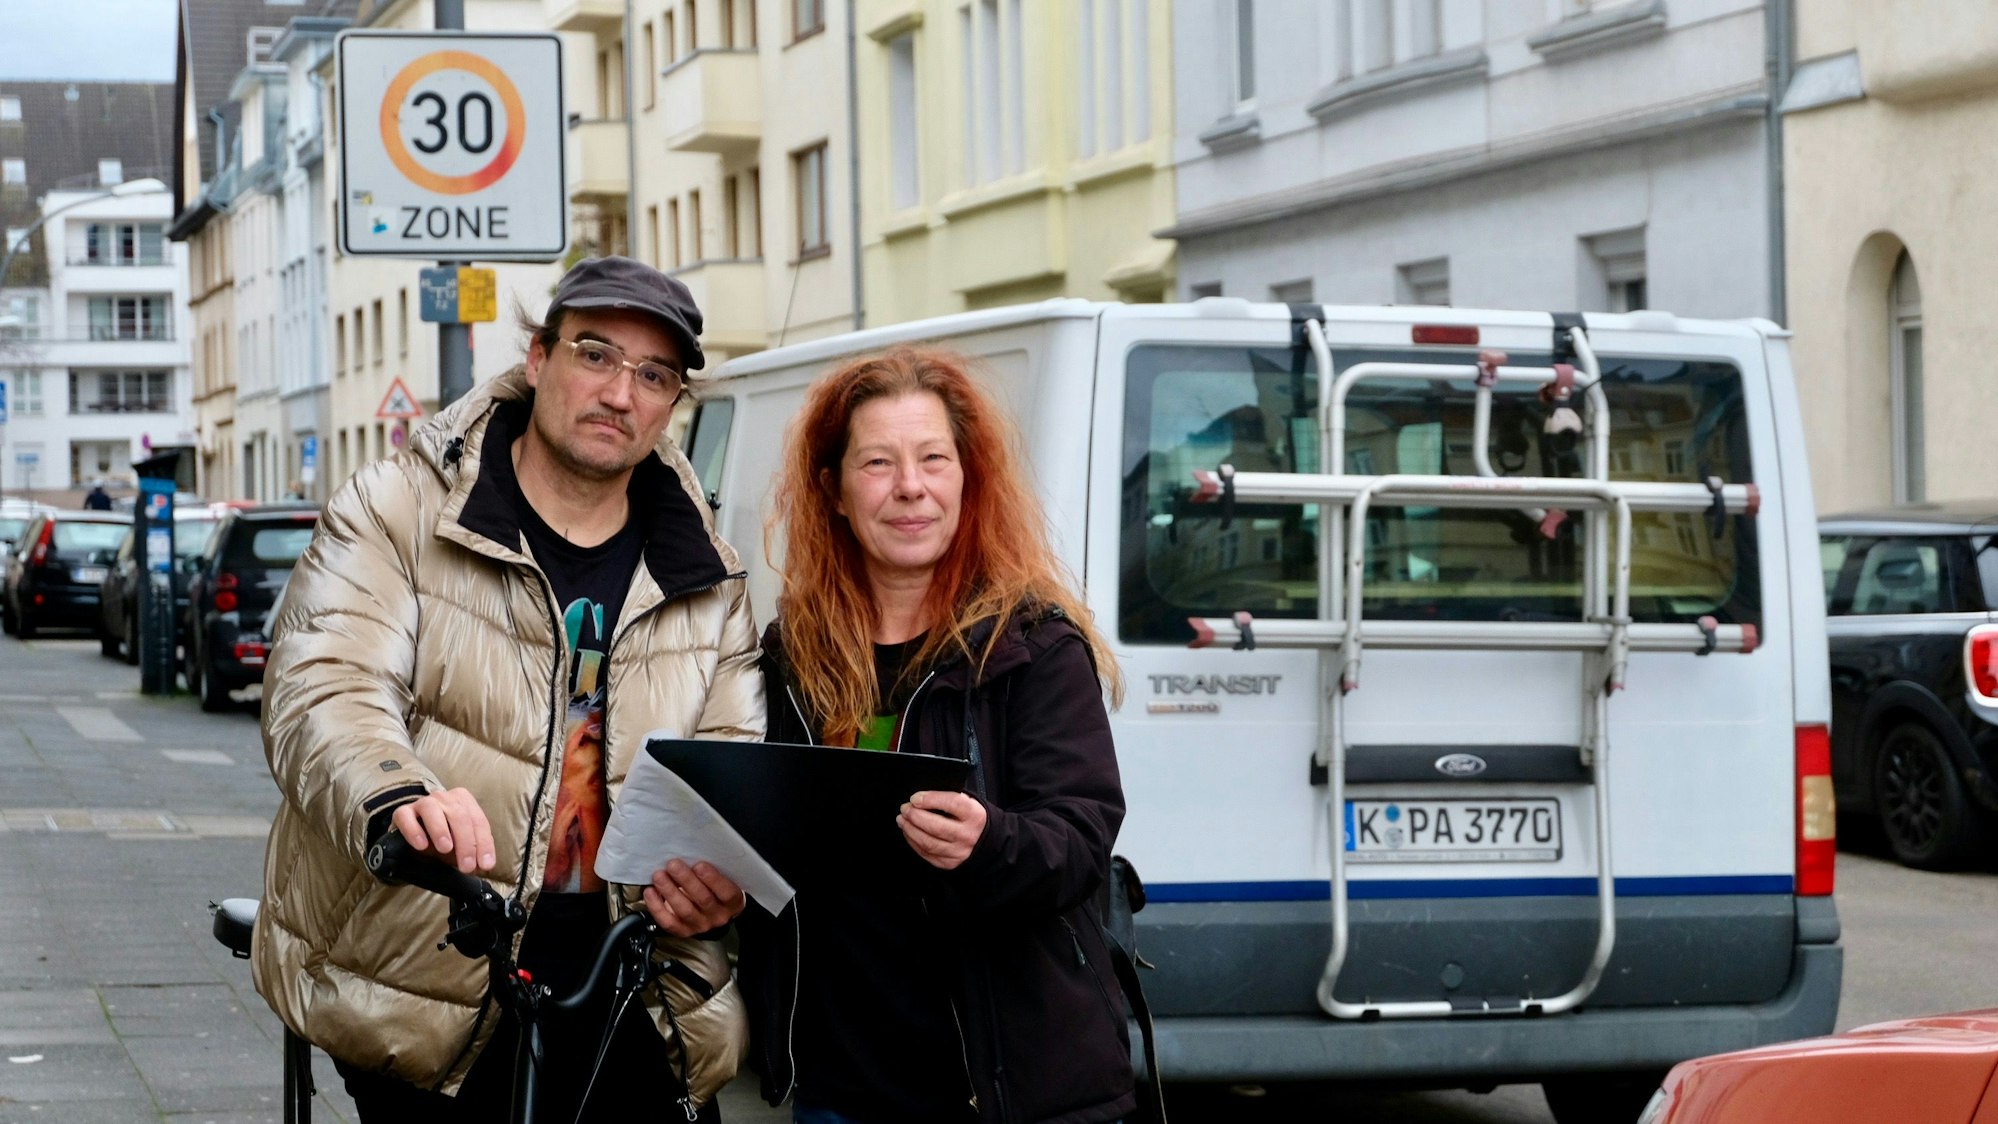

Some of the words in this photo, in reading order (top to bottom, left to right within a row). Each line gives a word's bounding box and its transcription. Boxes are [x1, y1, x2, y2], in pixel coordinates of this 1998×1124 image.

[412, 91, 493, 154] 30
[401, 206, 509, 239] ZONE
[1147, 674, 1282, 695] TRANSIT
[1359, 808, 1380, 843] K
[1408, 807, 1454, 843] PA
[1464, 807, 1552, 843] 3770
